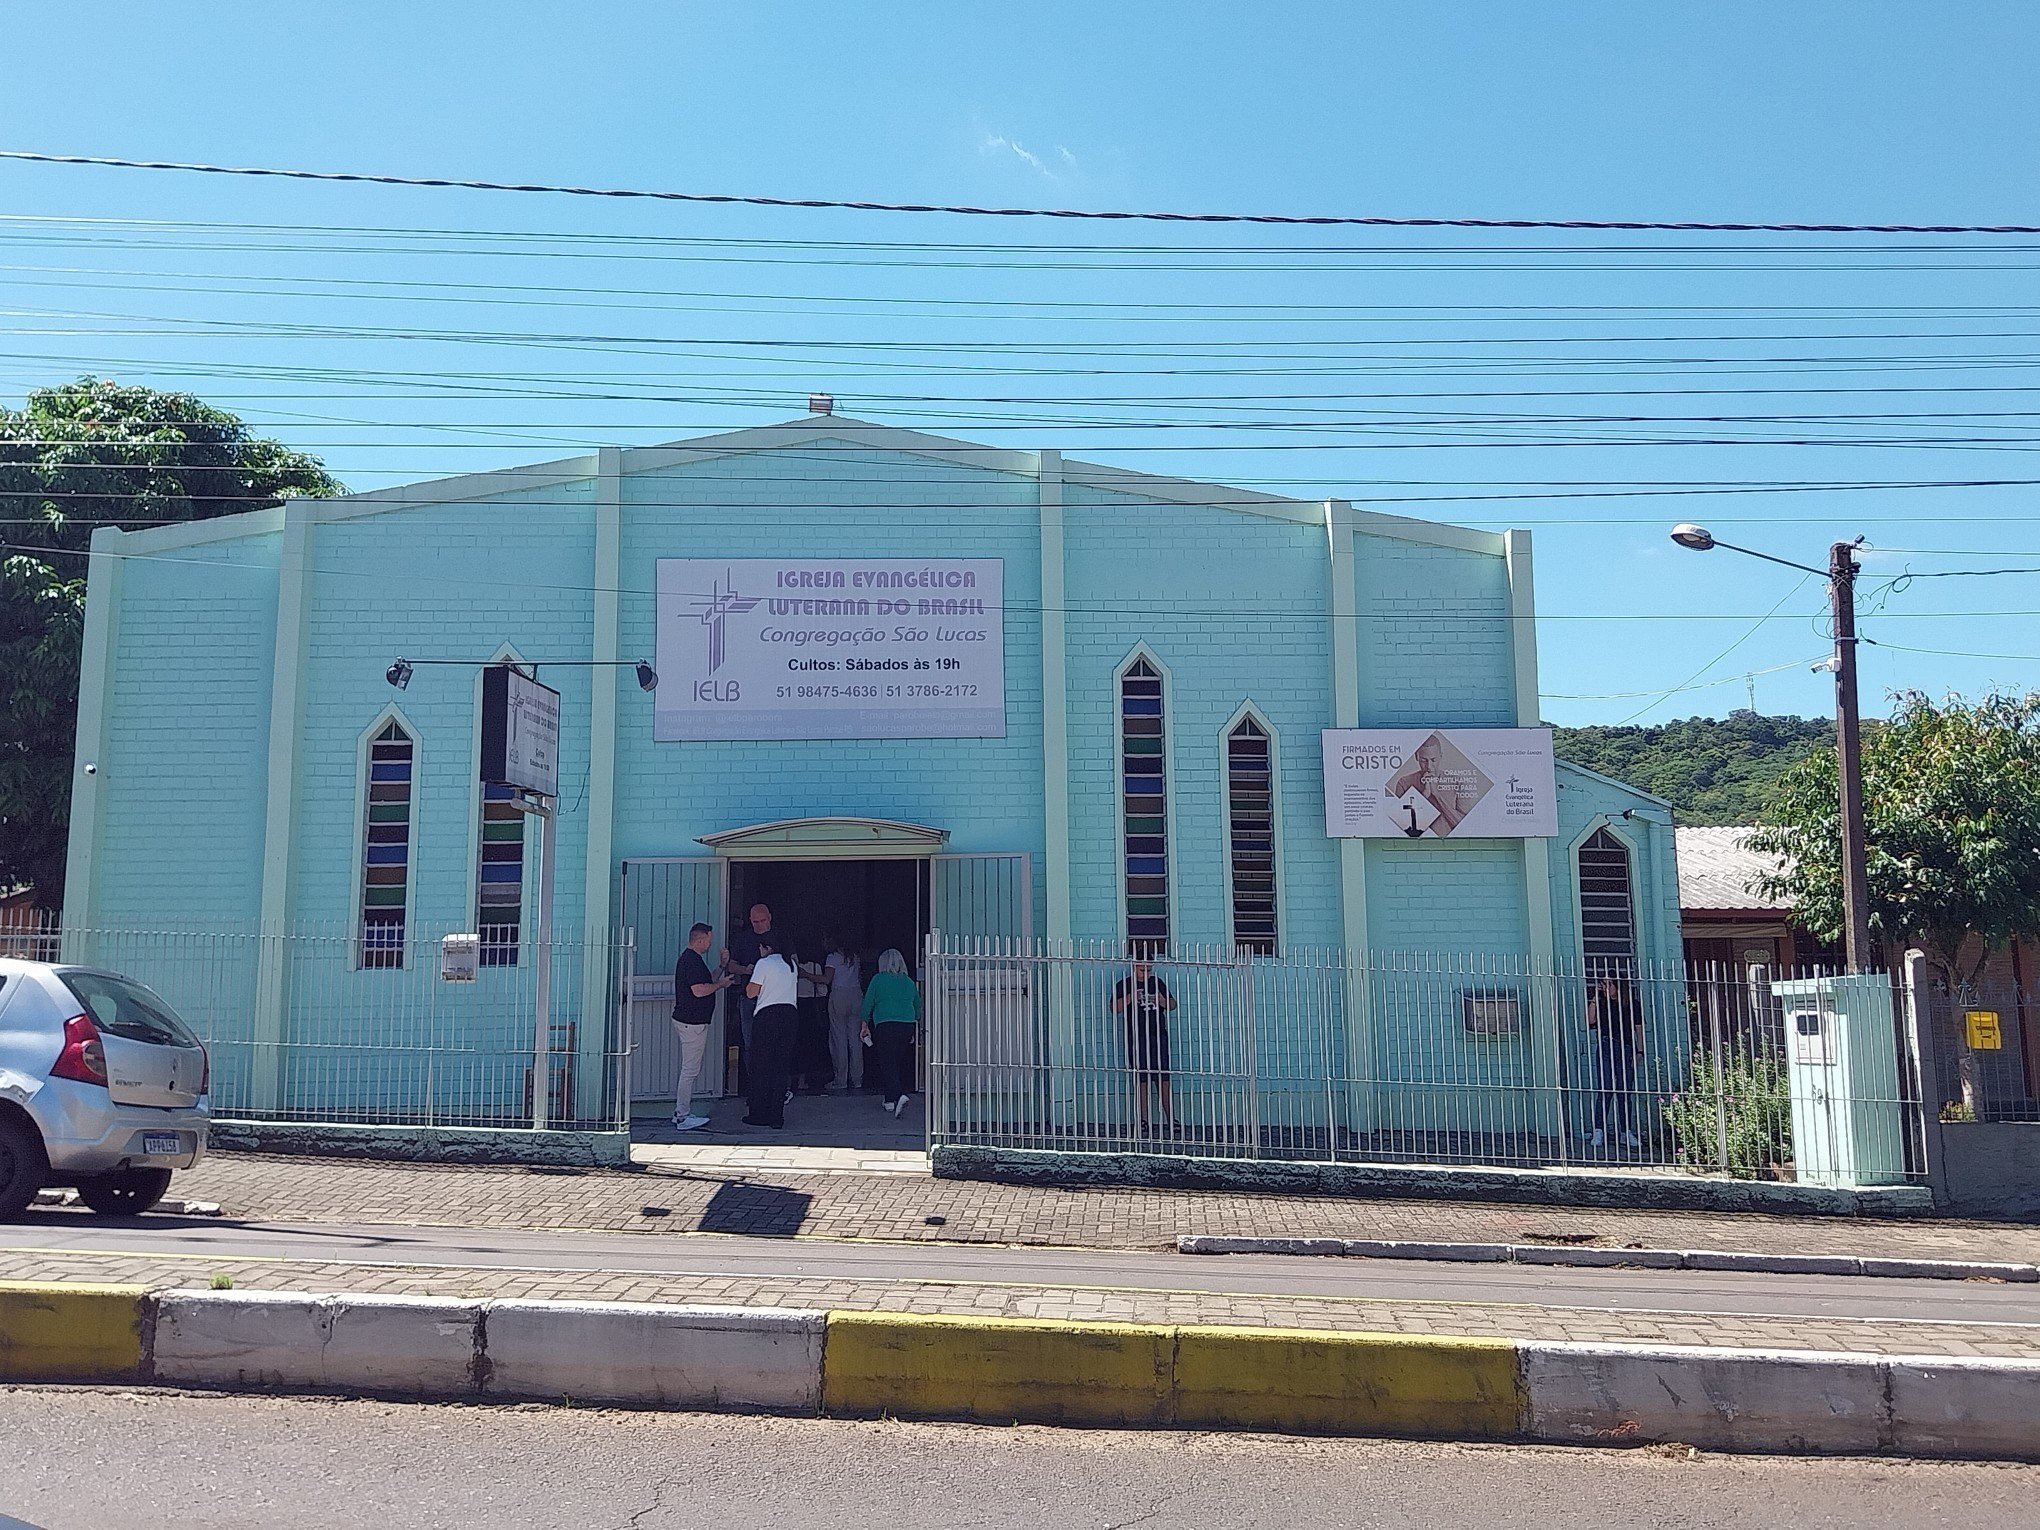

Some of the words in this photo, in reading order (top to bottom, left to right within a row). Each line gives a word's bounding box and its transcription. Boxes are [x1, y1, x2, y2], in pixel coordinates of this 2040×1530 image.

[777, 570, 845, 588] IGREJA
[852, 566, 976, 588] EVANGÉLICA
[768, 597, 870, 616] LUTERANA
[877, 598, 912, 616] DO
[918, 598, 985, 616] BRASIL
[759, 626, 886, 647] Congregação
[891, 626, 930, 642] São
[936, 627, 987, 642] Lucas
[788, 658, 841, 670] Cultos:
[845, 657, 909, 671] Sábados
[913, 658, 930, 670] às
[935, 658, 961, 670] 19h
[694, 680, 740, 702] IELB
[776, 686, 792, 698] 51
[797, 685, 877, 698] 98475-4636
[887, 686, 902, 697] 51
[906, 685, 978, 697] 3786-2172
[1342, 745, 1386, 753] FIRMADOS
[1342, 756, 1402, 769] CRISTO
